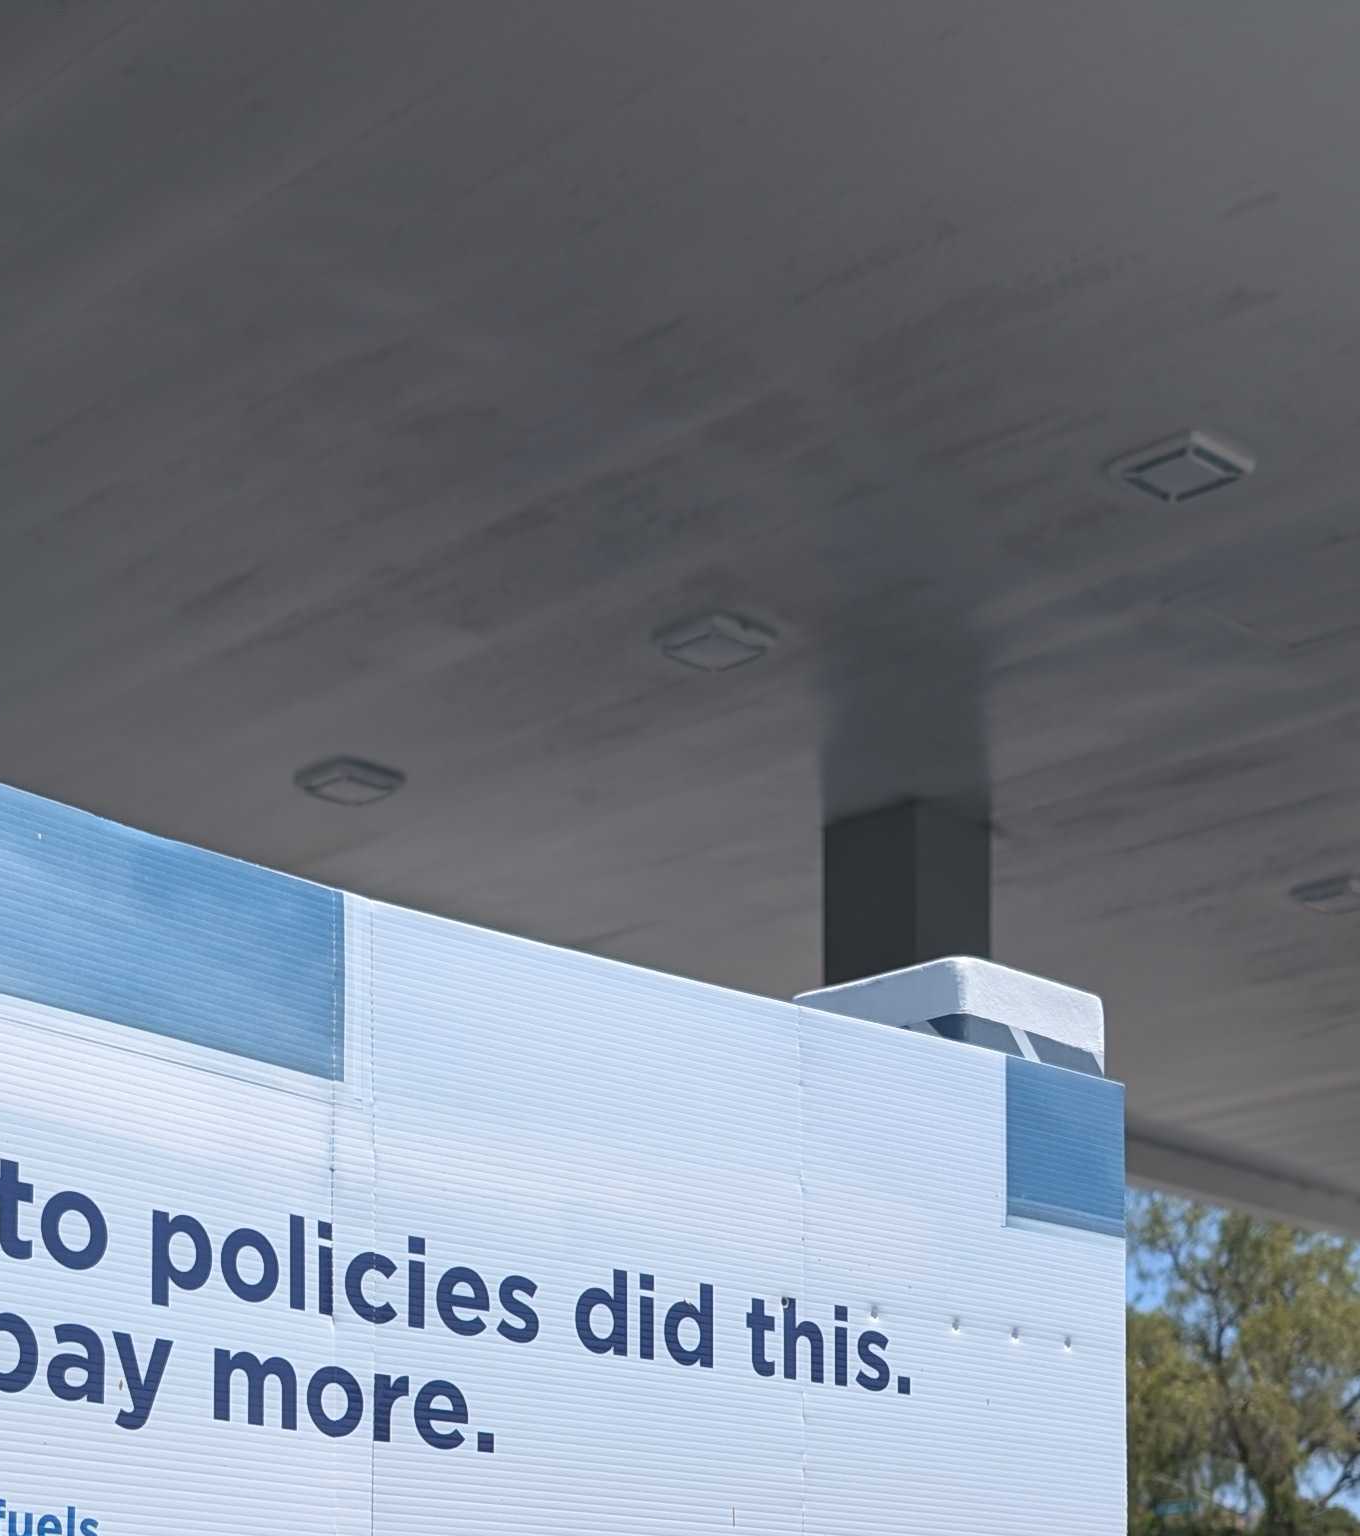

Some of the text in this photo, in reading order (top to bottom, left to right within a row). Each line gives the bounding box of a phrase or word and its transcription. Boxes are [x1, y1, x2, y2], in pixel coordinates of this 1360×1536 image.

[151, 1209, 540, 1344] policies
[574, 1268, 714, 1369] did
[746, 1296, 911, 1396] this.
[213, 1347, 496, 1454] more.
